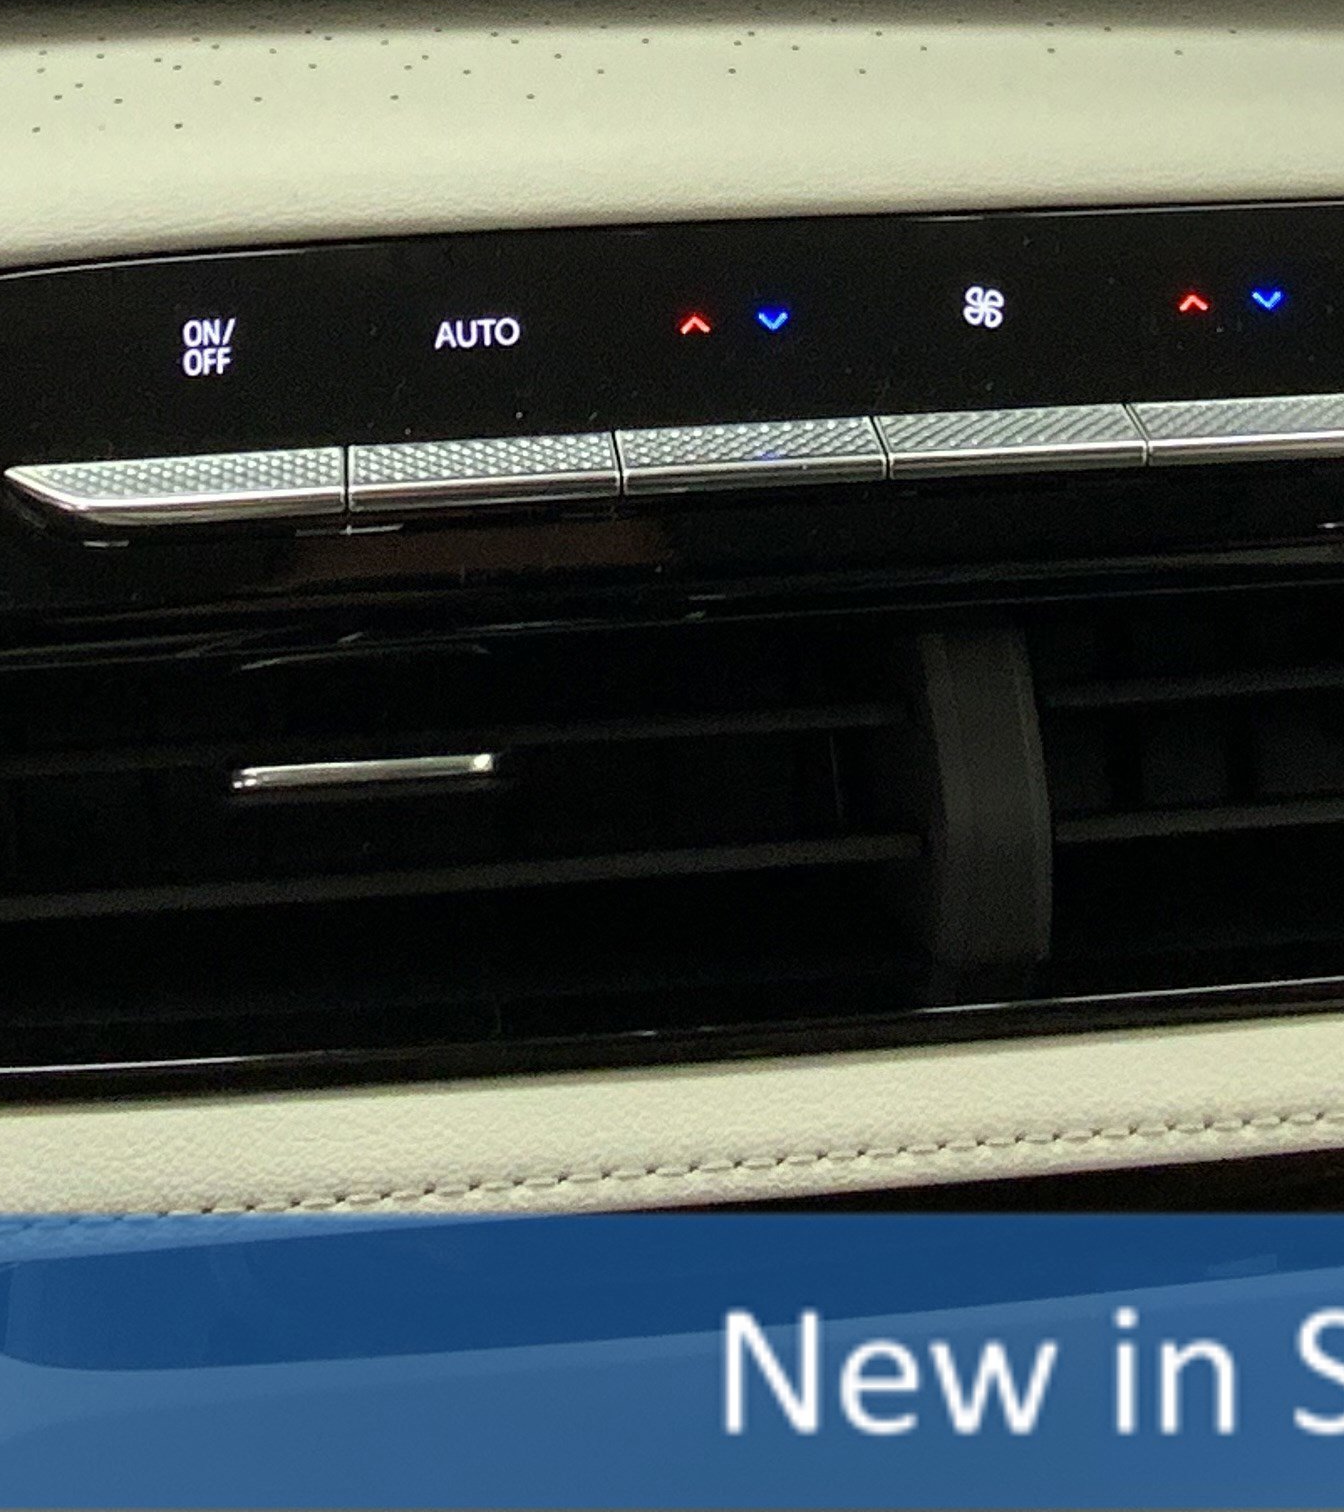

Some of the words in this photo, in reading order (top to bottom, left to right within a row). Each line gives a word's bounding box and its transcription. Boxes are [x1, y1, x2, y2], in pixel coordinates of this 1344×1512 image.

[182, 317, 237, 348] ON/
[434, 316, 521, 350] AUTO
[182, 348, 232, 377] OFF
